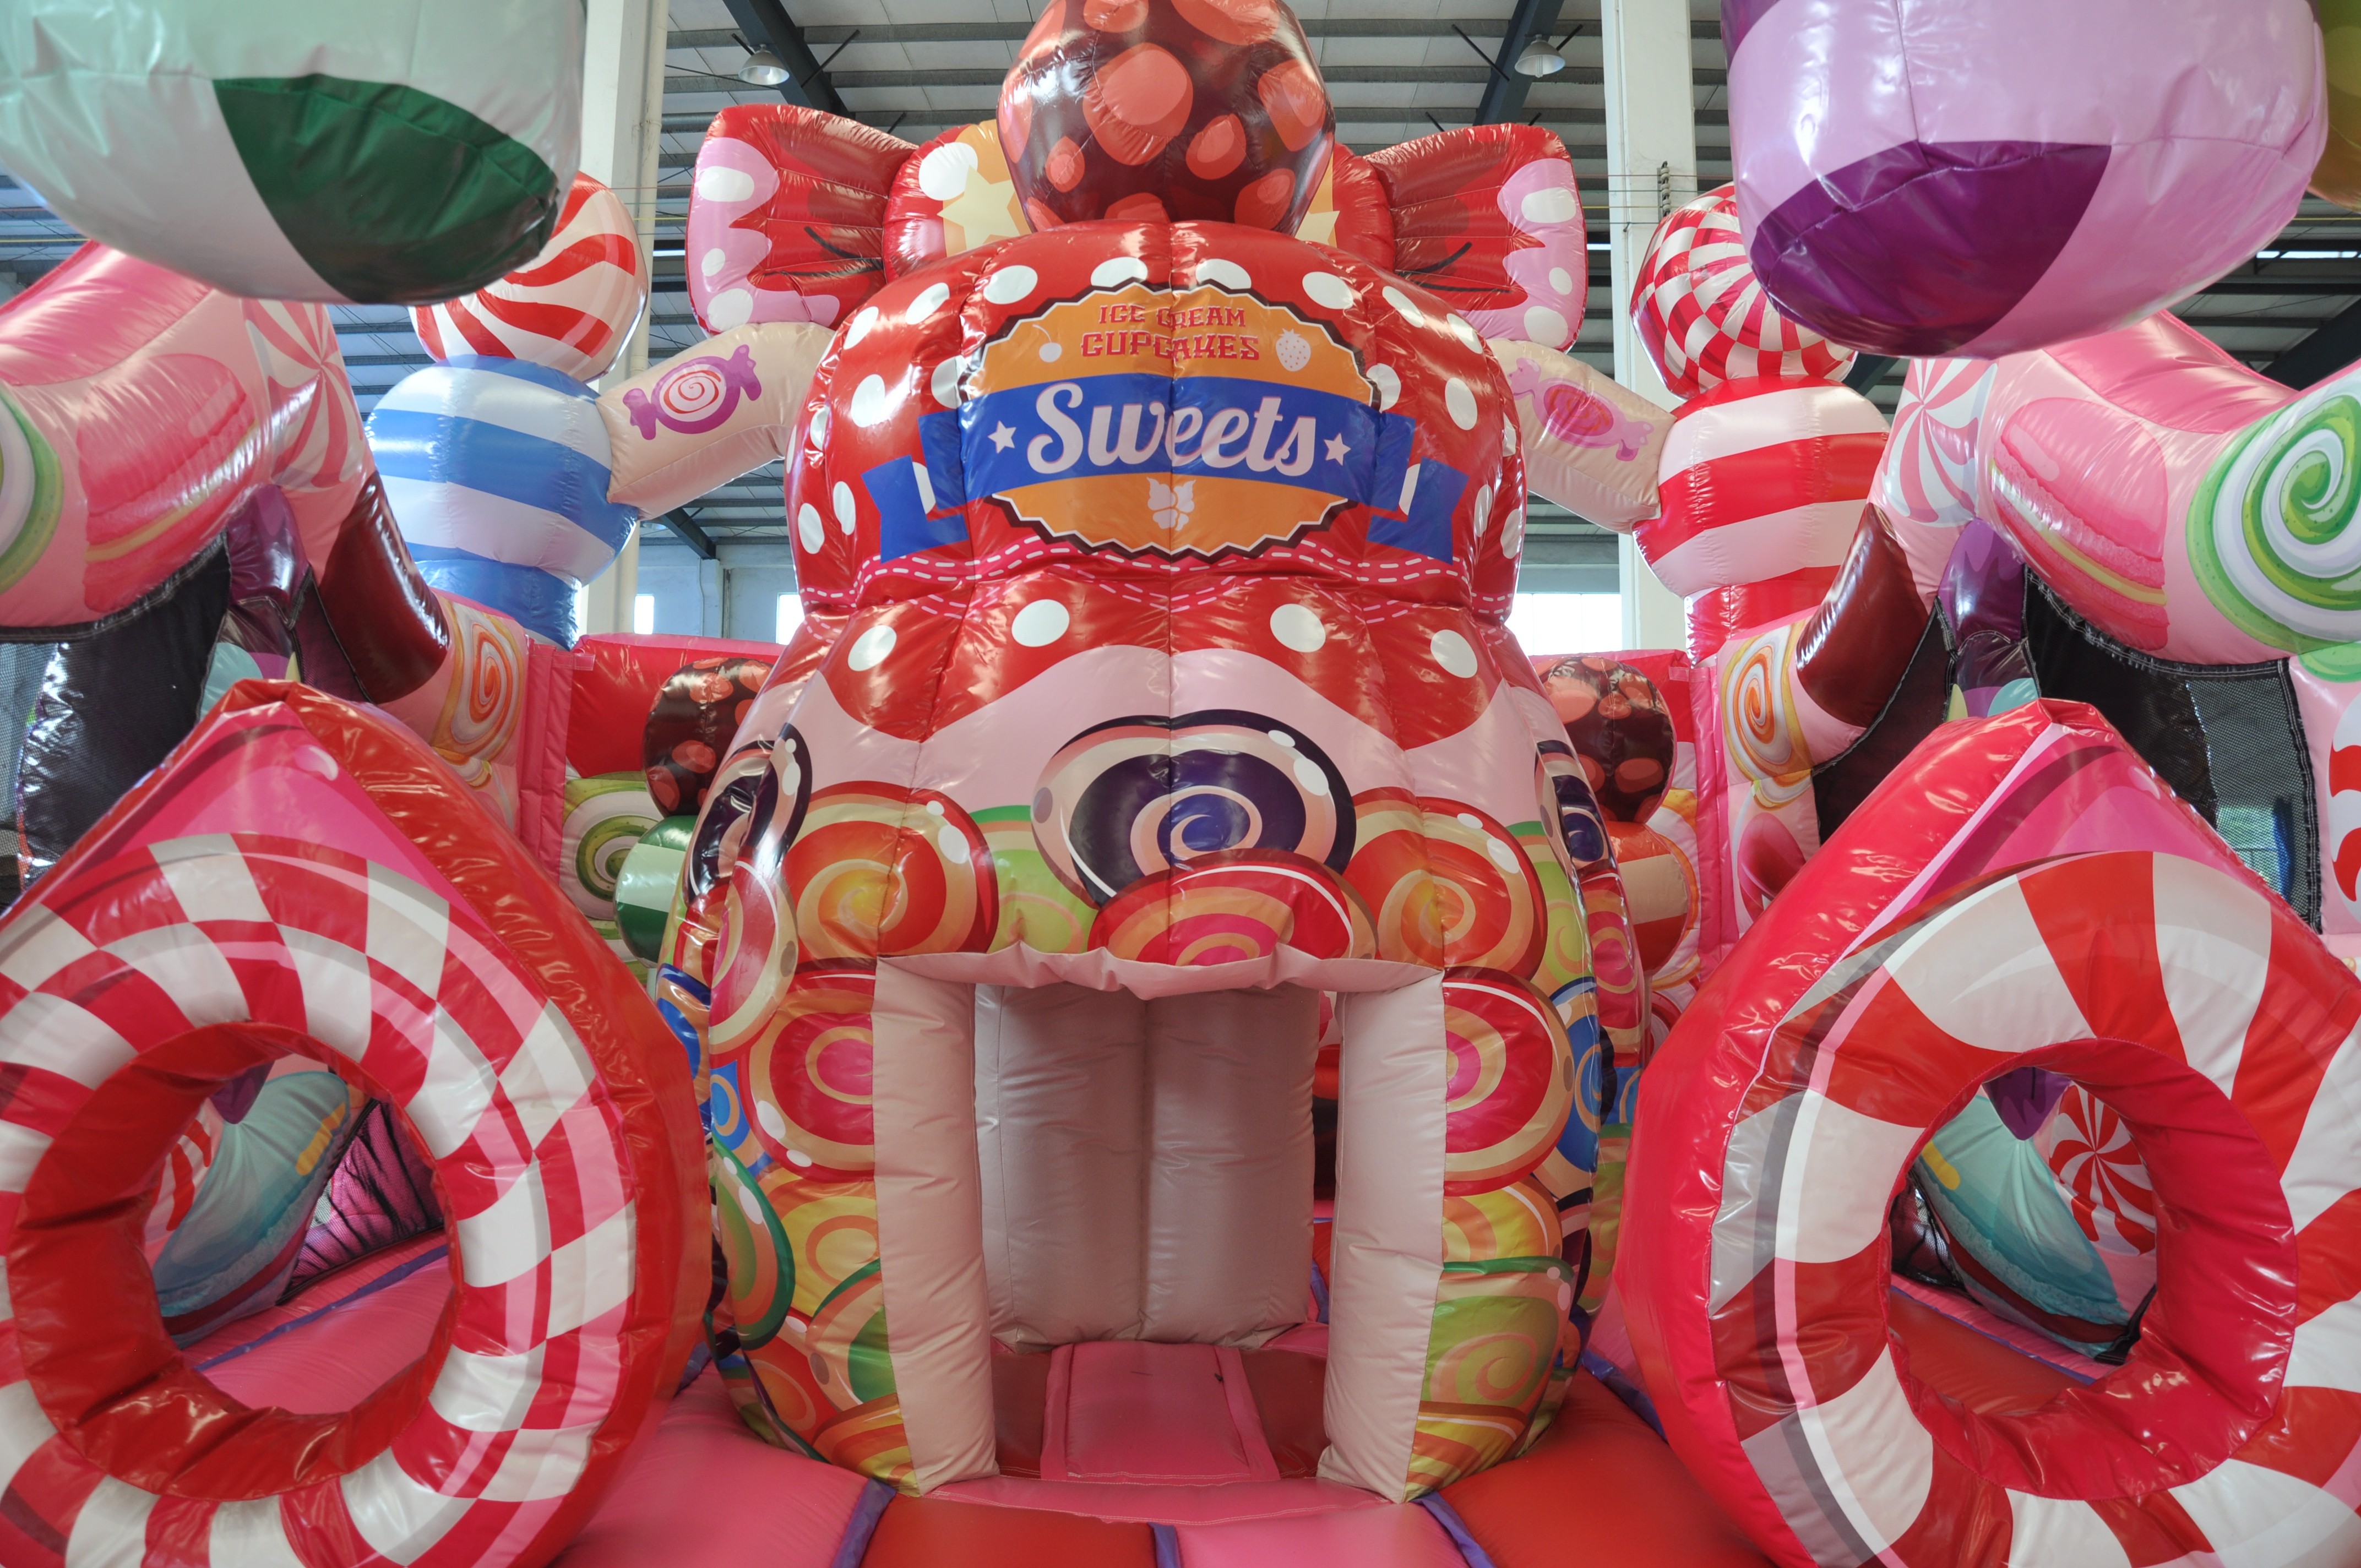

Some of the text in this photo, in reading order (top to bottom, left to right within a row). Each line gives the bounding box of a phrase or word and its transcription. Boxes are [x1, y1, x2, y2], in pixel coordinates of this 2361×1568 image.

[1098, 304, 1246, 330] ICE CREAM
[1080, 331, 1260, 362] CUPCAKES
[1026, 382, 1316, 477] Sweets
